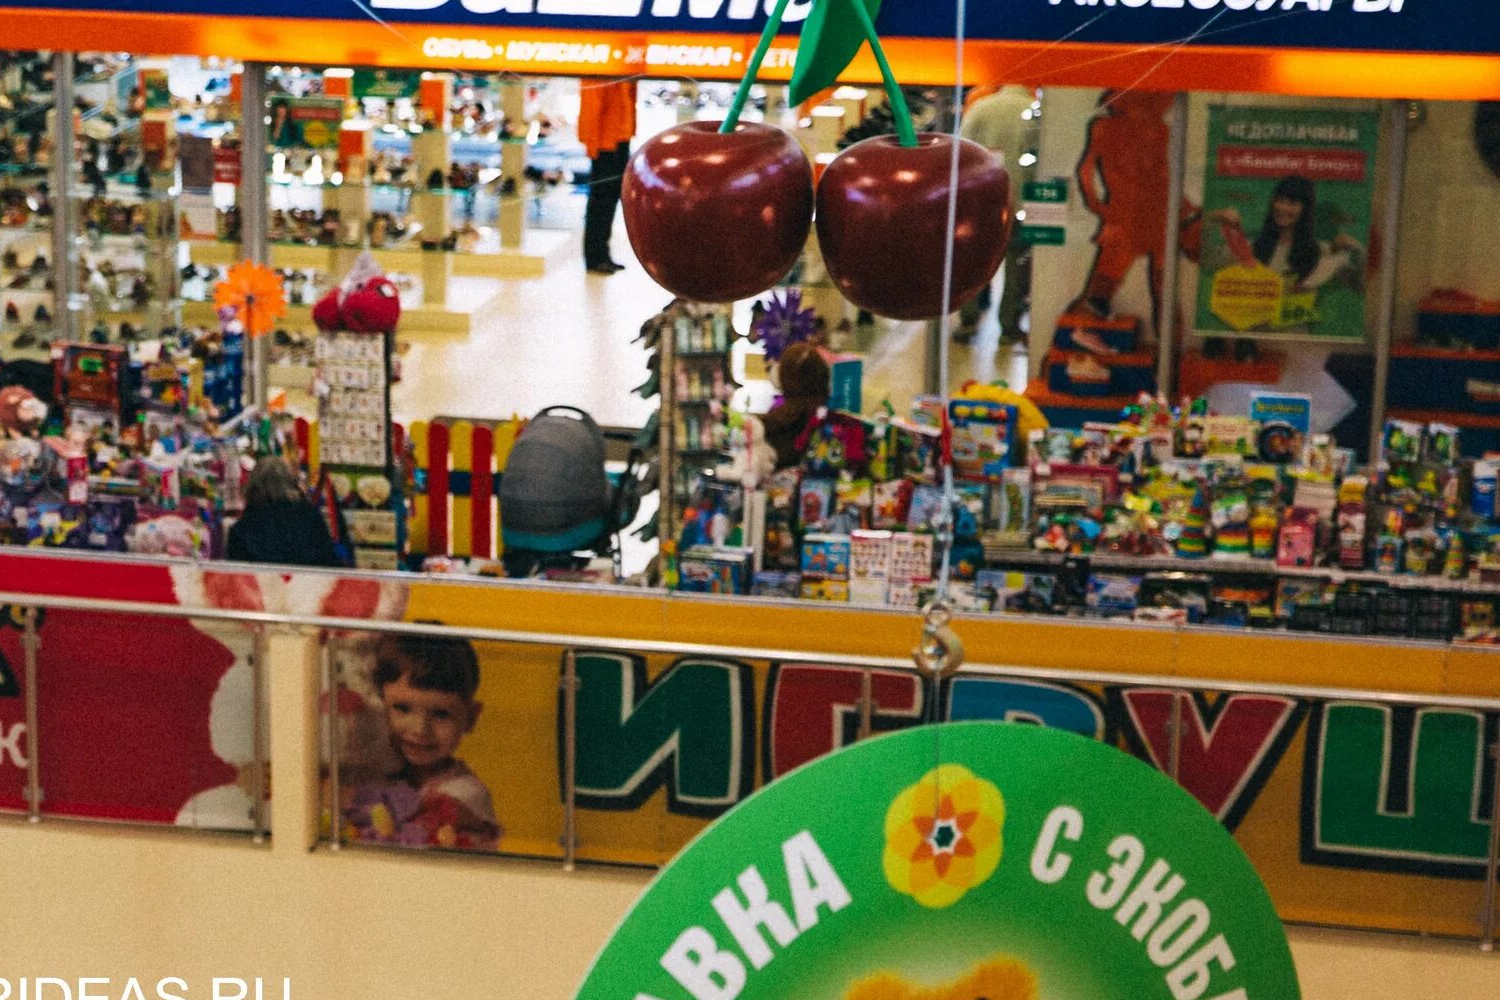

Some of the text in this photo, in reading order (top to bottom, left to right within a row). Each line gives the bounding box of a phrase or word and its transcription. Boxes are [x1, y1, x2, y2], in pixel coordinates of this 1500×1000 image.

[423, 37, 493, 59] ОБУВЬ
[506, 40, 610, 64] МУЖСКАЯ
[624, 44, 732, 67] ЖЕНСКАЯ
[1029, 805, 1085, 884] С
